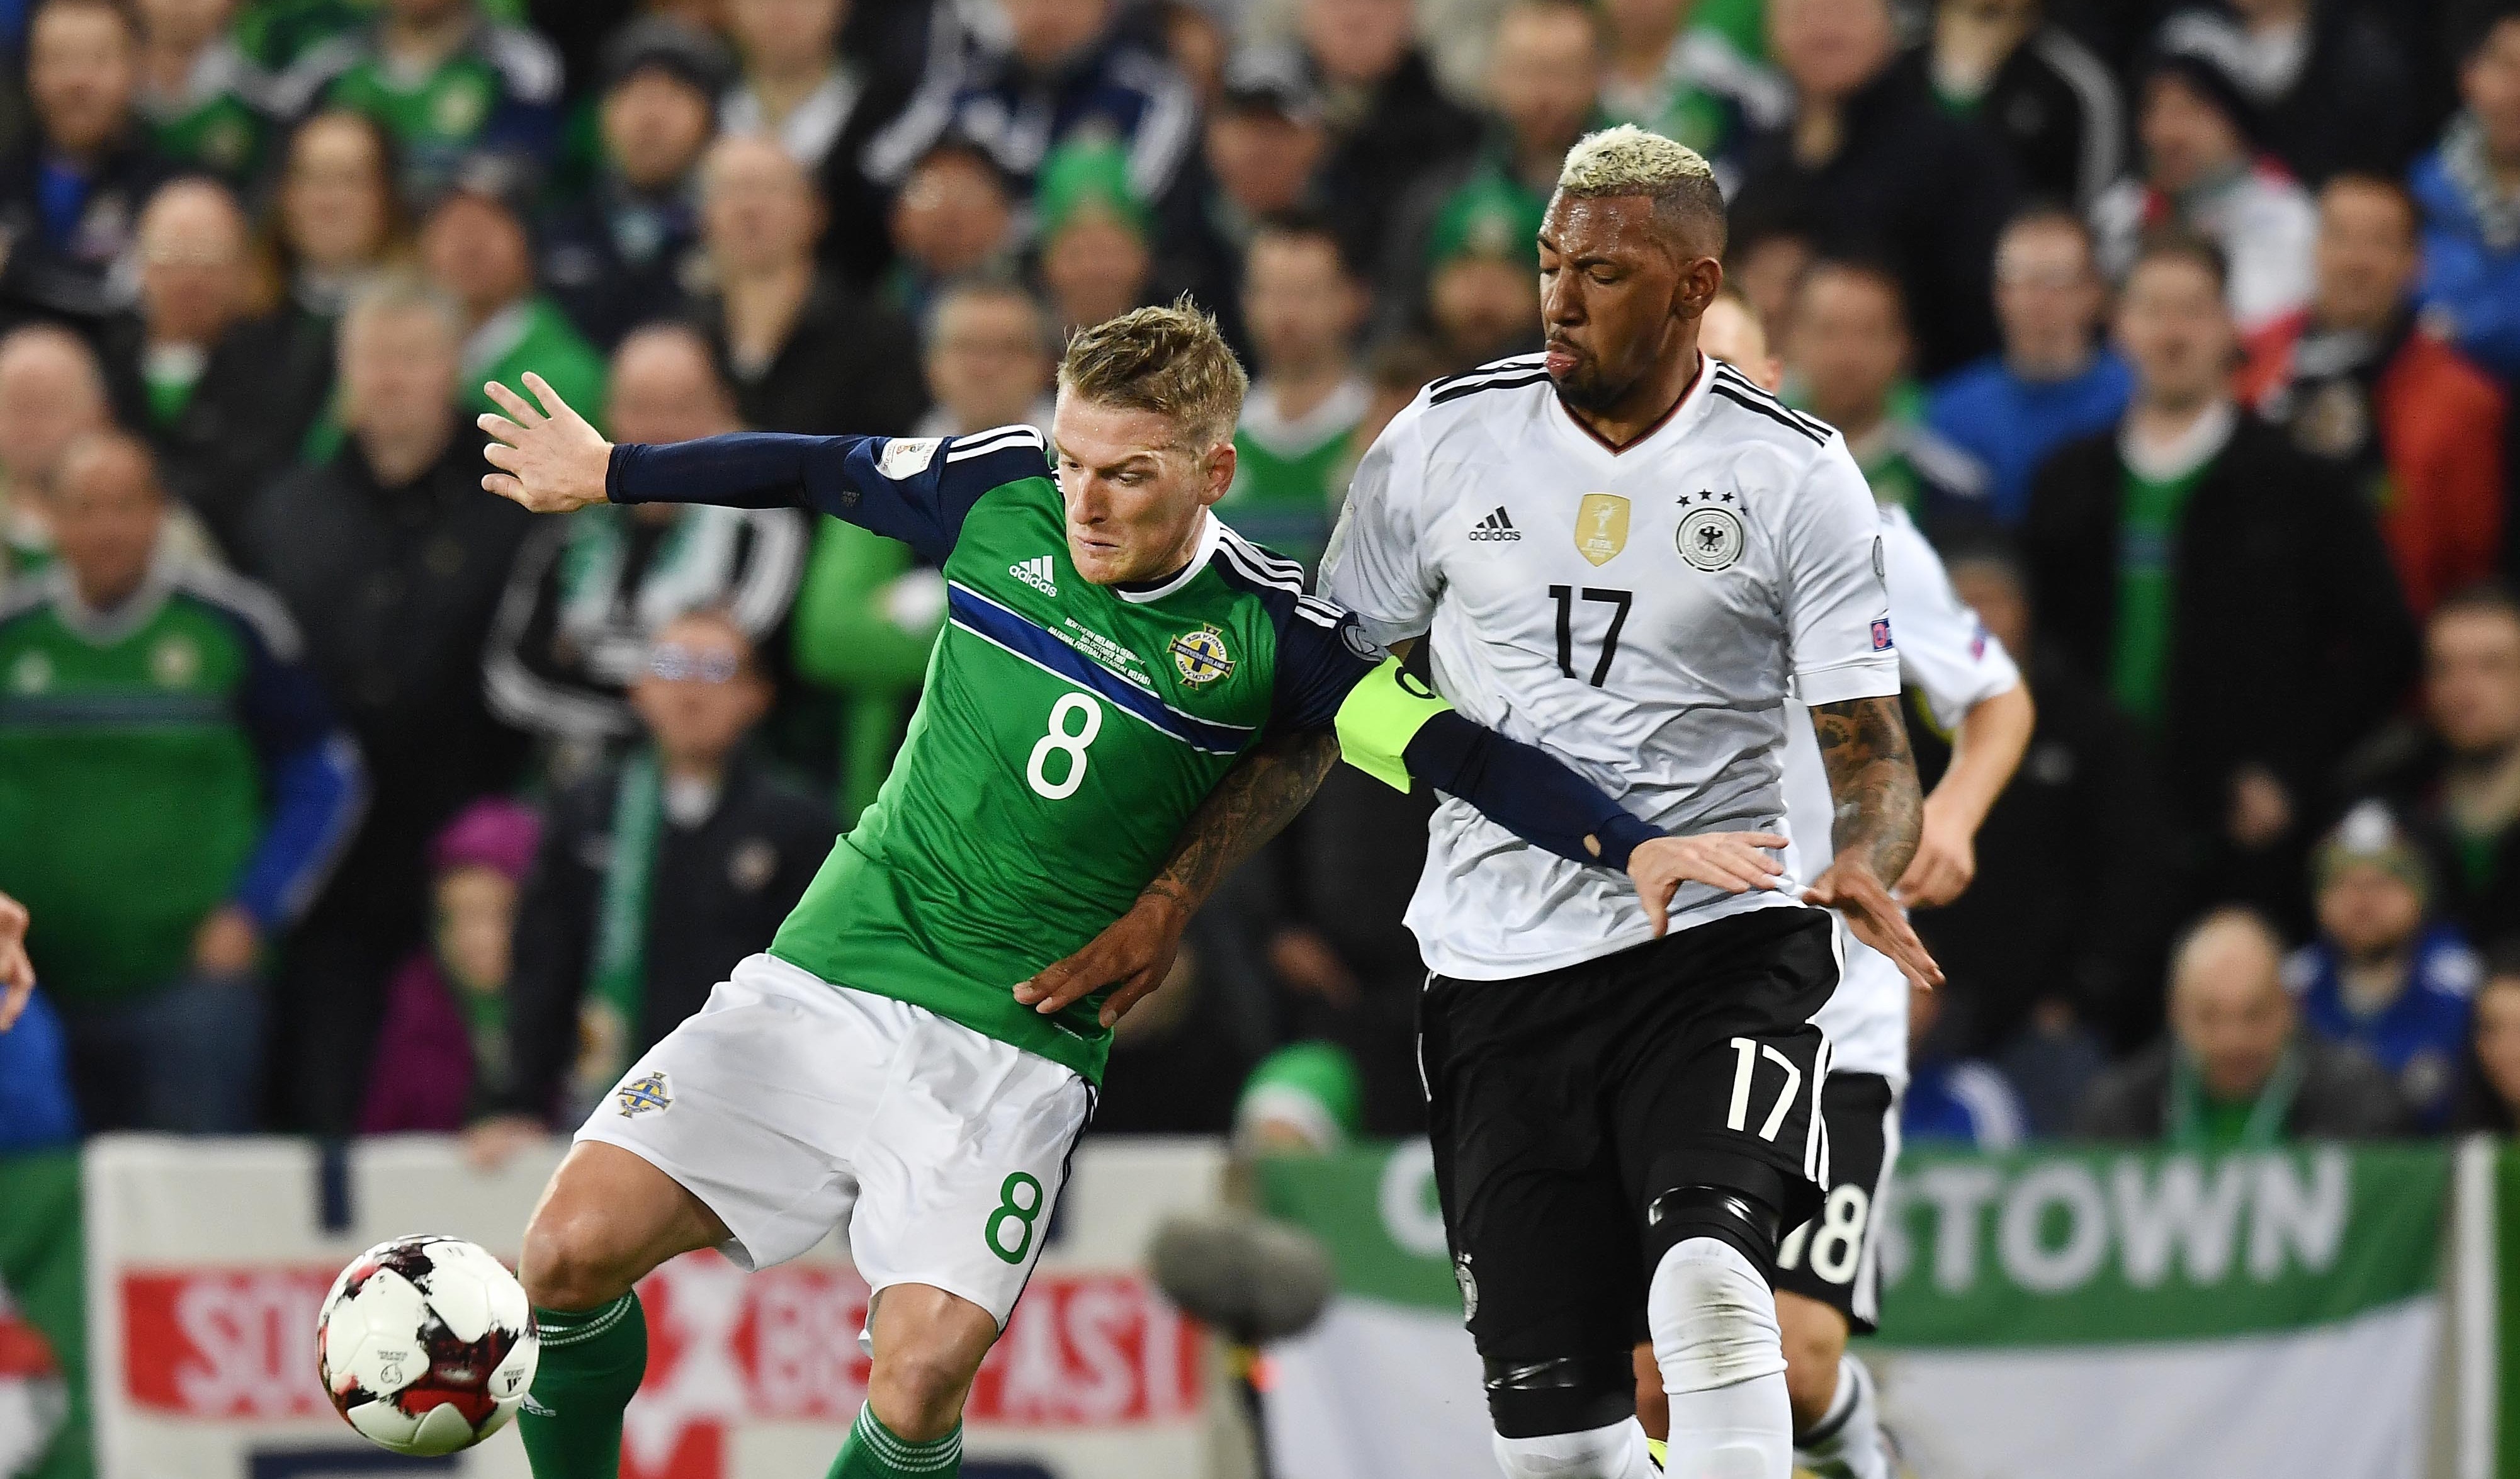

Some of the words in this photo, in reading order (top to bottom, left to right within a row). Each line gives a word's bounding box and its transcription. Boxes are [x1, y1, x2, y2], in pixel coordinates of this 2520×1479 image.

[1469, 528, 1522, 541] adidas
[1009, 565, 1058, 598] adidas
[1047, 626, 1075, 647] NATIONAL
[1073, 640, 1102, 660] FOOTBALL
[1090, 640, 1116, 657] OCTOBER
[1093, 635, 1116, 652] IRELAND
[1549, 584, 1632, 688] 17
[1027, 692, 1102, 800] 8
[1727, 1037, 1801, 1143] 17
[985, 1172, 1043, 1265] 8
